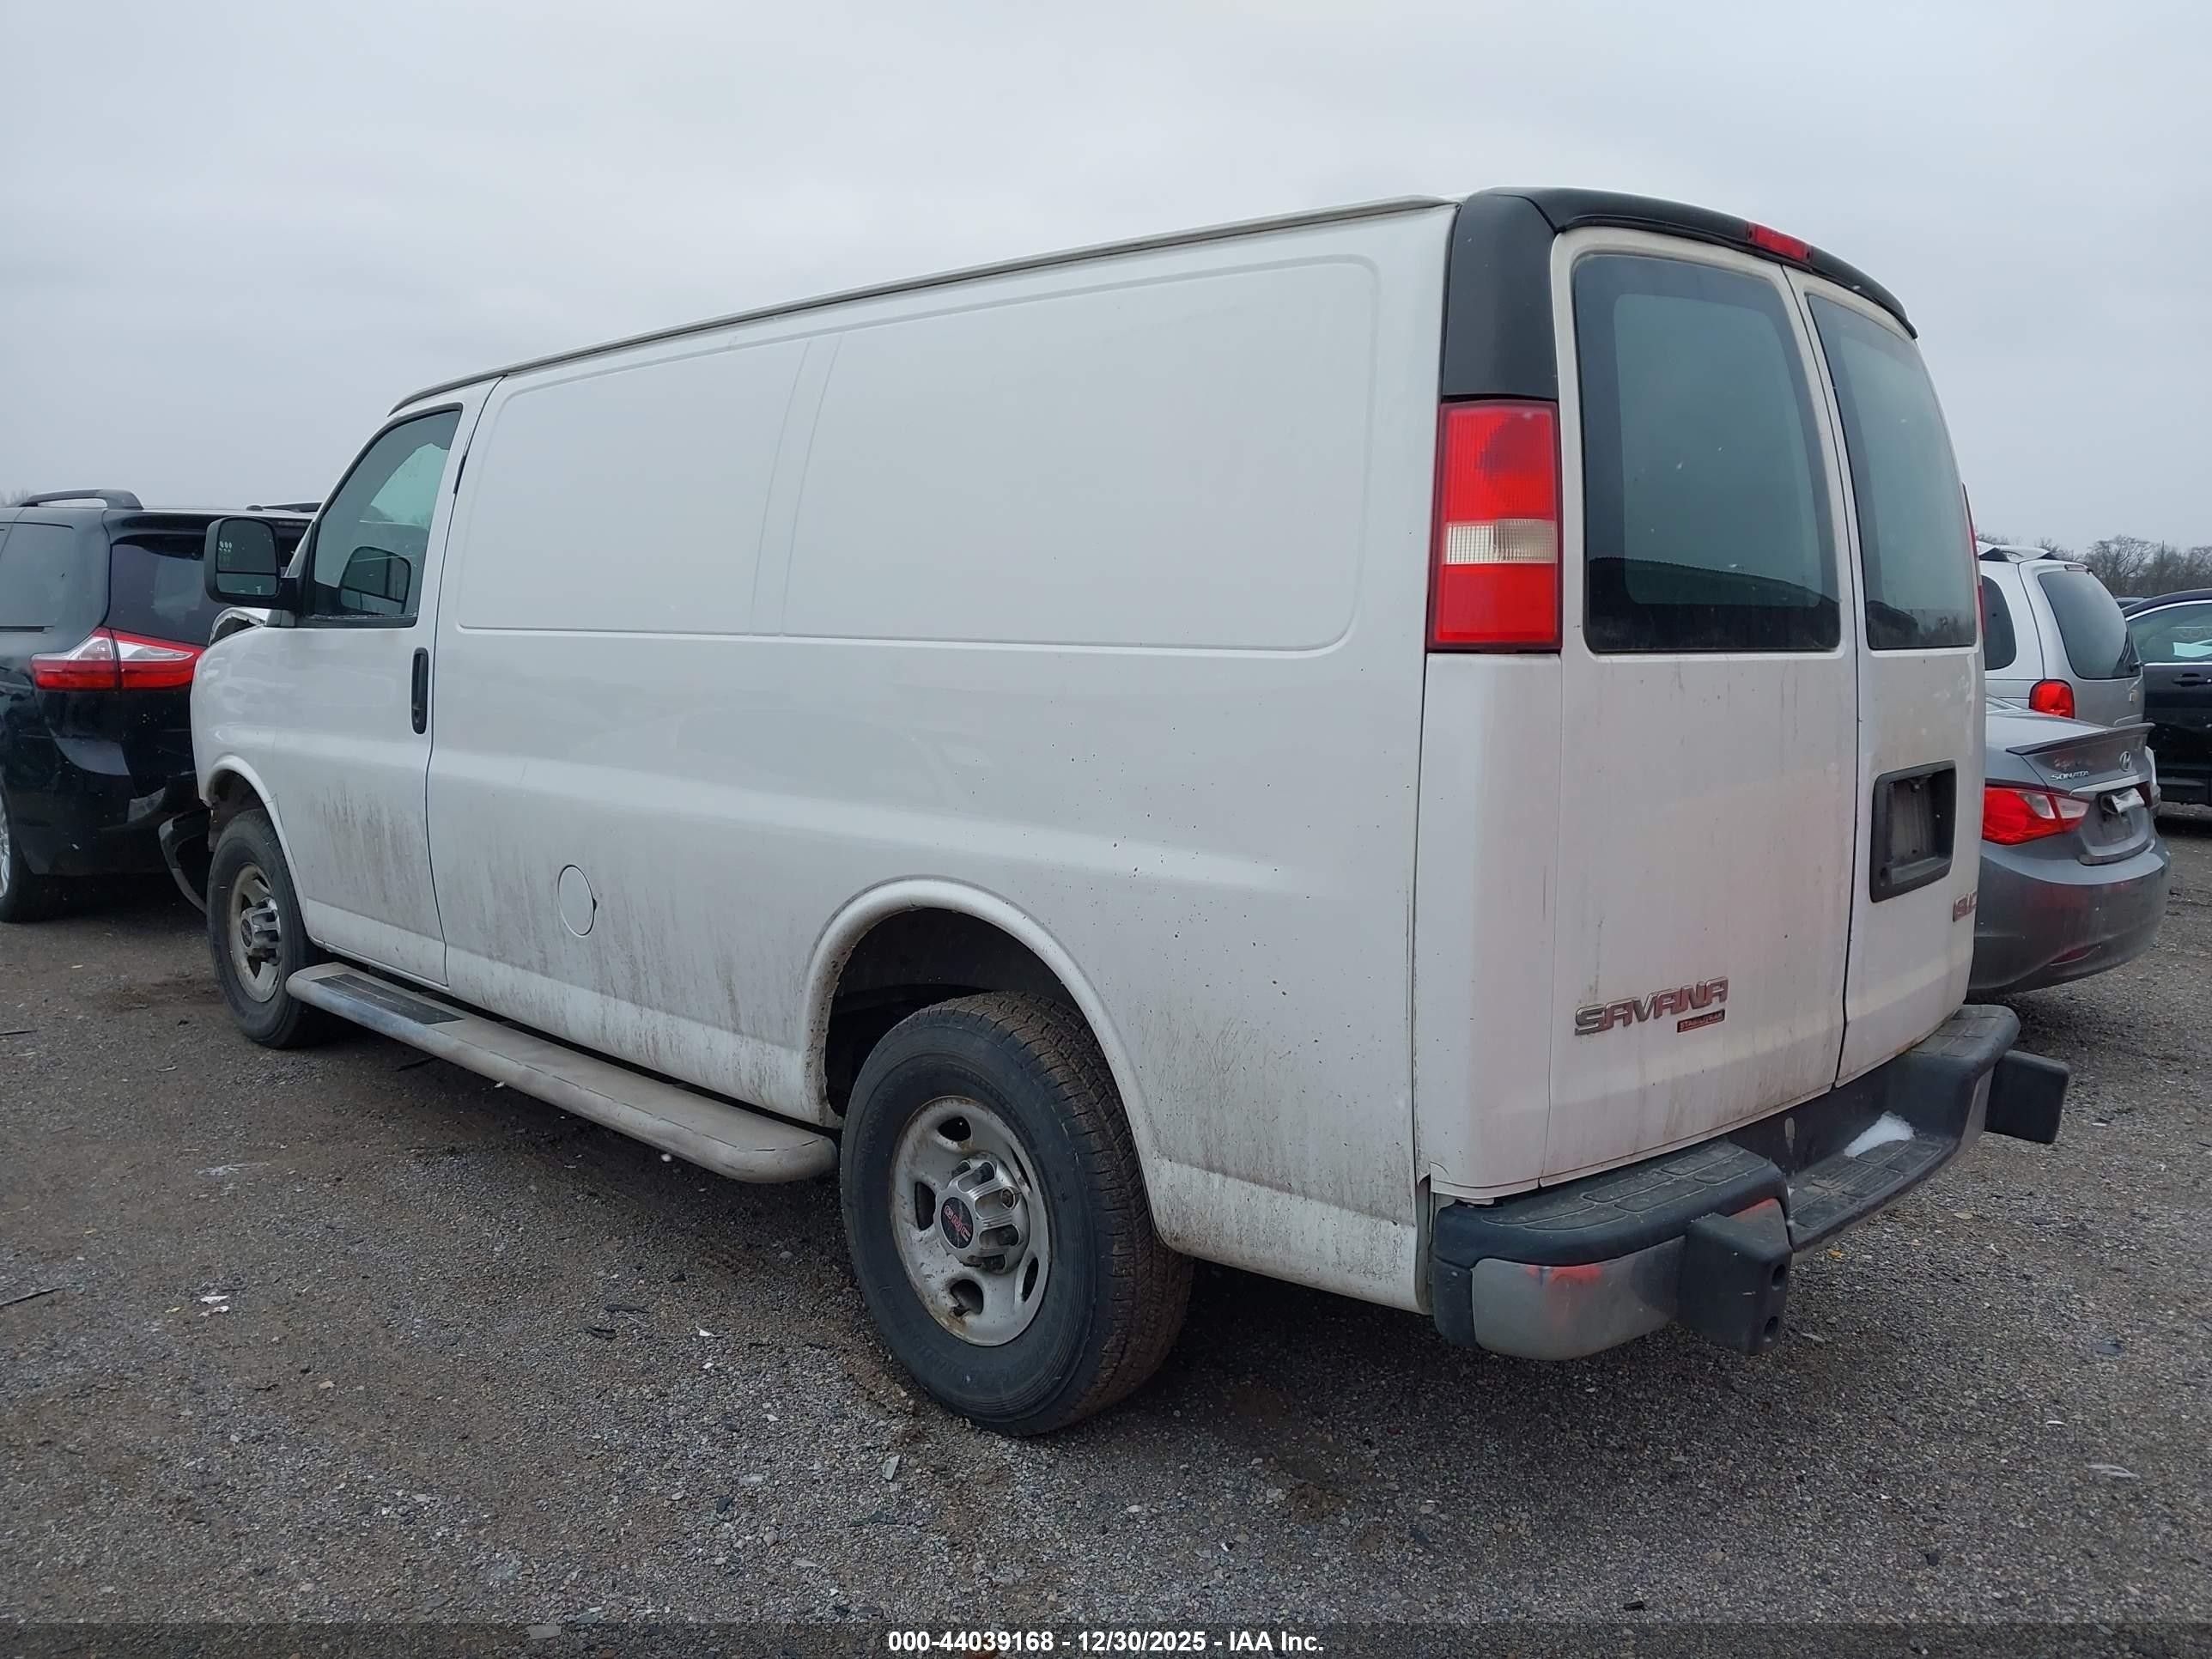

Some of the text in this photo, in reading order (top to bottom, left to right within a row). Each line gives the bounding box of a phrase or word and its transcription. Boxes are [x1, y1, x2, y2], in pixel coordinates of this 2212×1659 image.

[2050, 770, 2089, 781] SONATA
[1575, 976, 1729, 1036] SAVANA
[944, 1205, 971, 1243] GMC
